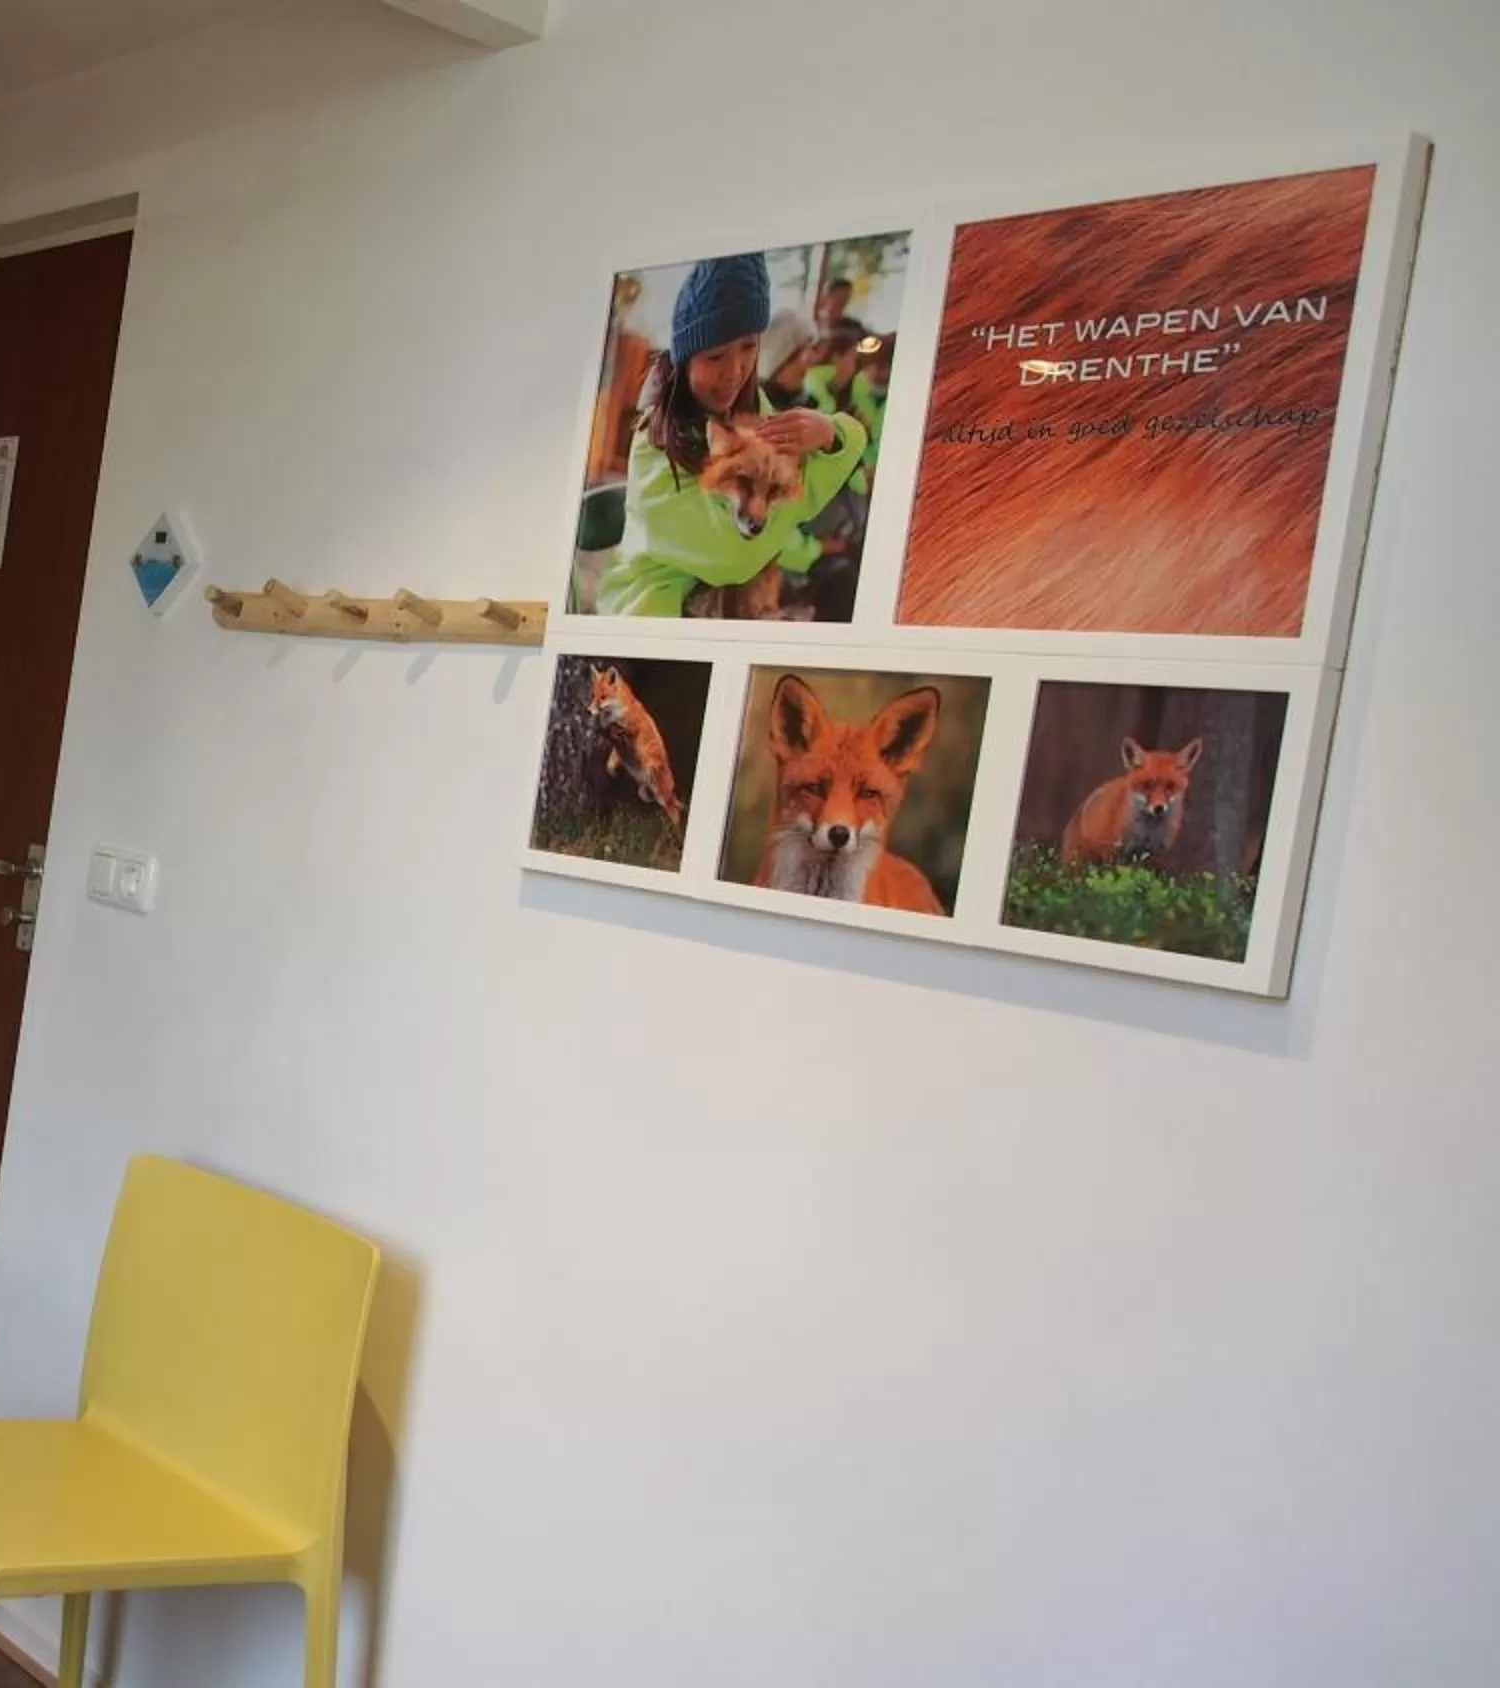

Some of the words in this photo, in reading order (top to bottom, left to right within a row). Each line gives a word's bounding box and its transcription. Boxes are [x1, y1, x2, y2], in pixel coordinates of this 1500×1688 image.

[1074, 306, 1220, 342] WAPEN
[1234, 295, 1328, 325] VAN
[1027, 414, 1055, 438] in
[1067, 409, 1131, 442] goed
[1144, 401, 1321, 439] gezelschap
